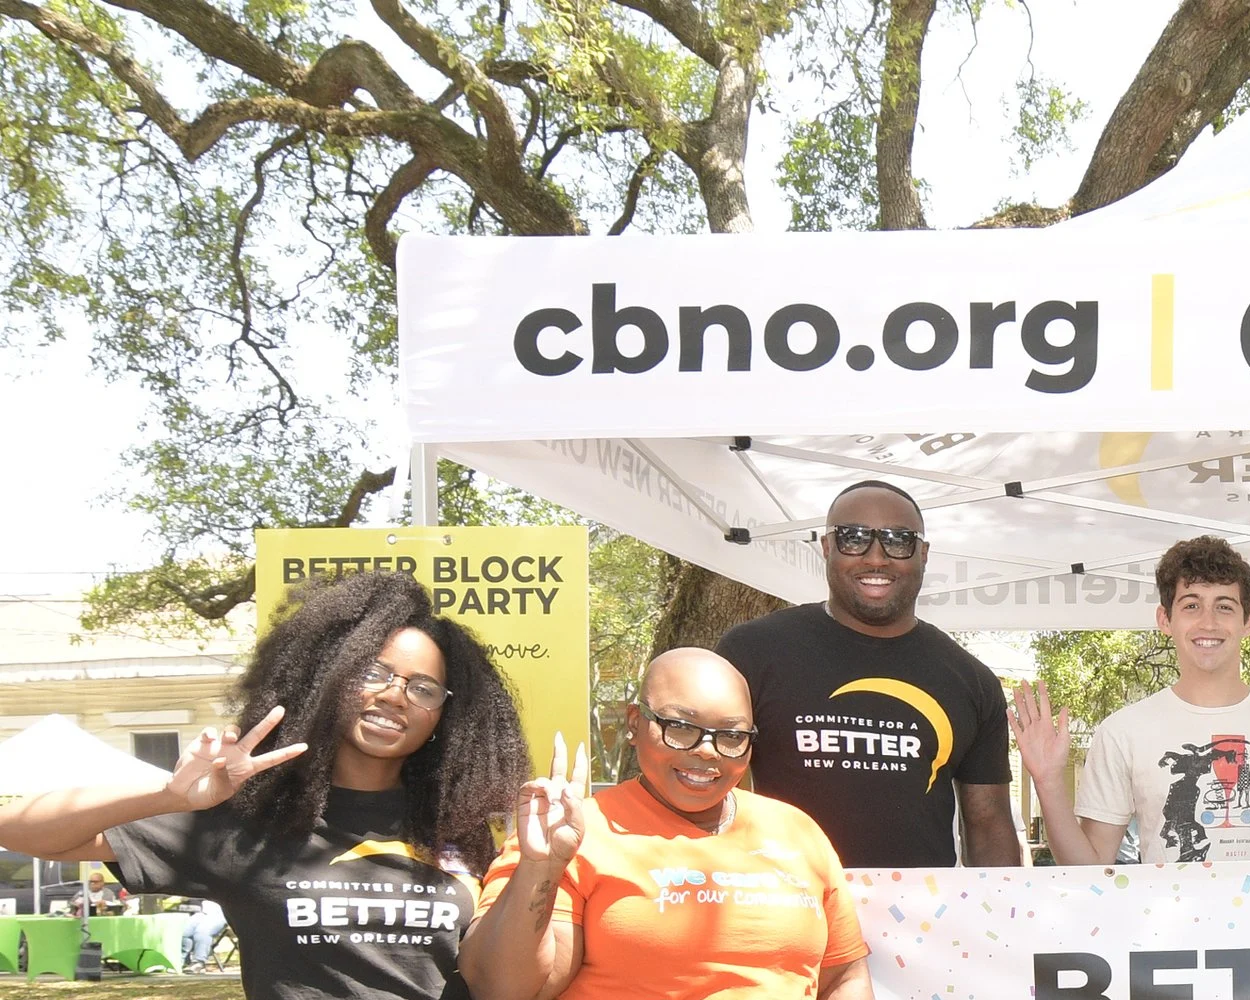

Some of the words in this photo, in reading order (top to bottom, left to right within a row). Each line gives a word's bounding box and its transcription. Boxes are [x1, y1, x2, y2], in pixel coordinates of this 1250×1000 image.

[514, 283, 1098, 393] cbno.org
[433, 556, 564, 583] BLOCK
[433, 587, 560, 615] PARTY
[795, 715, 873, 727] COMMITTEE
[879, 720, 904, 730] FOR
[910, 722, 918, 731] A
[796, 730, 922, 758] BETTER
[804, 759, 835, 769] NEW
[842, 760, 908, 772] ORLEANS
[286, 881, 394, 893] COMMITTEE
[403, 883, 437, 894] FOR
[445, 886, 457, 895] A
[653, 887, 692, 914] for
[697, 889, 730, 905] our
[286, 896, 460, 930] BETTER
[297, 934, 341, 945] NEW
[350, 933, 433, 946] ORLEANS
